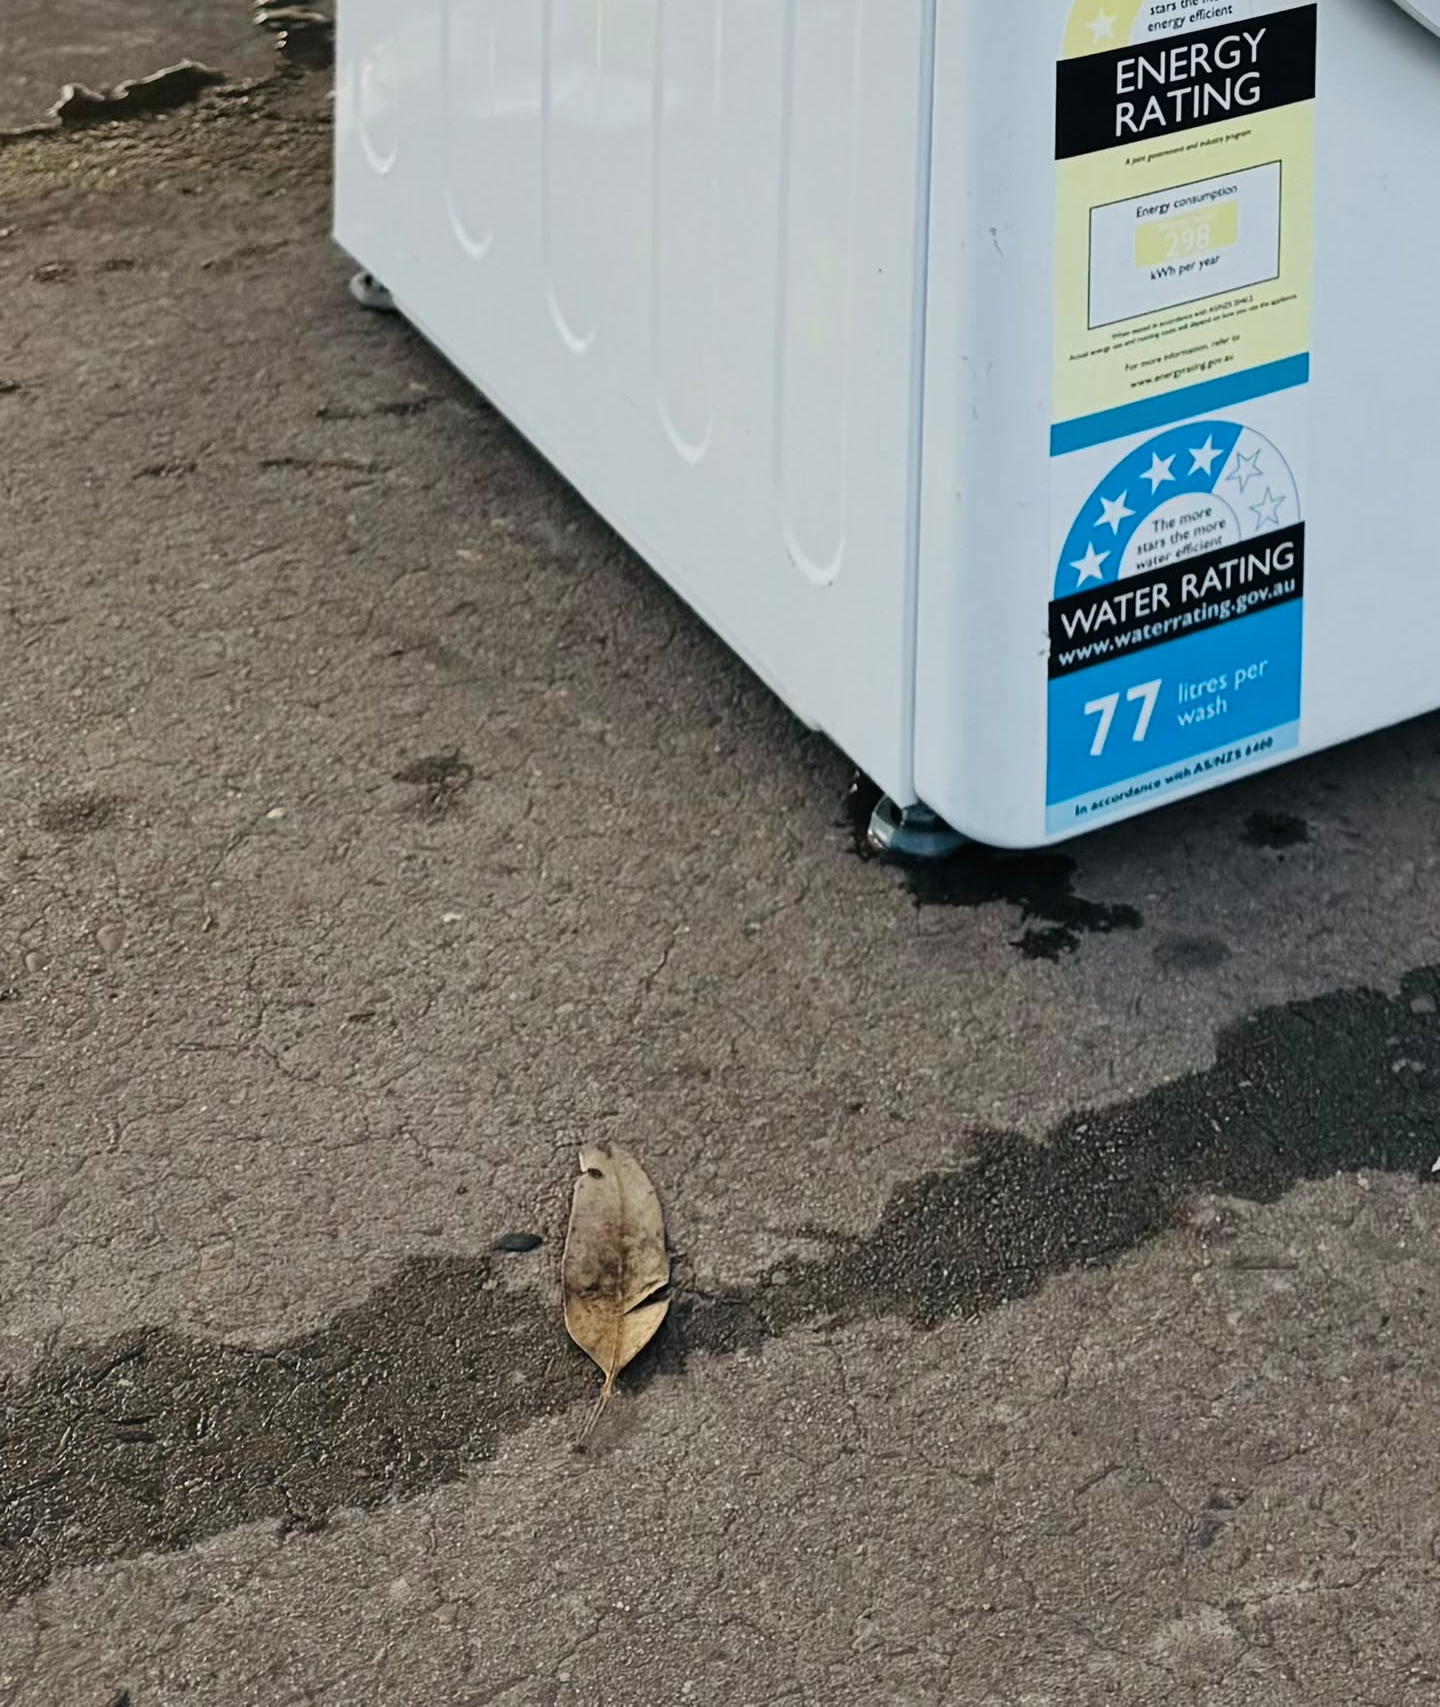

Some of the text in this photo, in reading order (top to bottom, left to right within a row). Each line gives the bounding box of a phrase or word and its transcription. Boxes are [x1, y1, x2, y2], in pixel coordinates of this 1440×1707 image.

[1147, 4, 1233, 32] energy efficient
[1150, 1, 1177, 16] stars
[1116, 28, 1267, 95] ENERGY
[1115, 71, 1261, 137] RATING
[1136, 185, 1238, 218] Energy consumption
[1150, 255, 1221, 280] kWh per year
[1137, 519, 1226, 555] stars the more
[1152, 507, 1212, 533] The more
[1136, 536, 1223, 570] water efficient
[1060, 542, 1295, 639] WATER RATING
[1058, 578, 1296, 667] www.waterrating.gov.au
[1177, 658, 1269, 705] litres per
[1084, 677, 1163, 757] 77
[1177, 698, 1228, 728] wash
[1075, 804, 1087, 816] In
[1091, 780, 1161, 810] accordance
[1164, 768, 1191, 785] with
